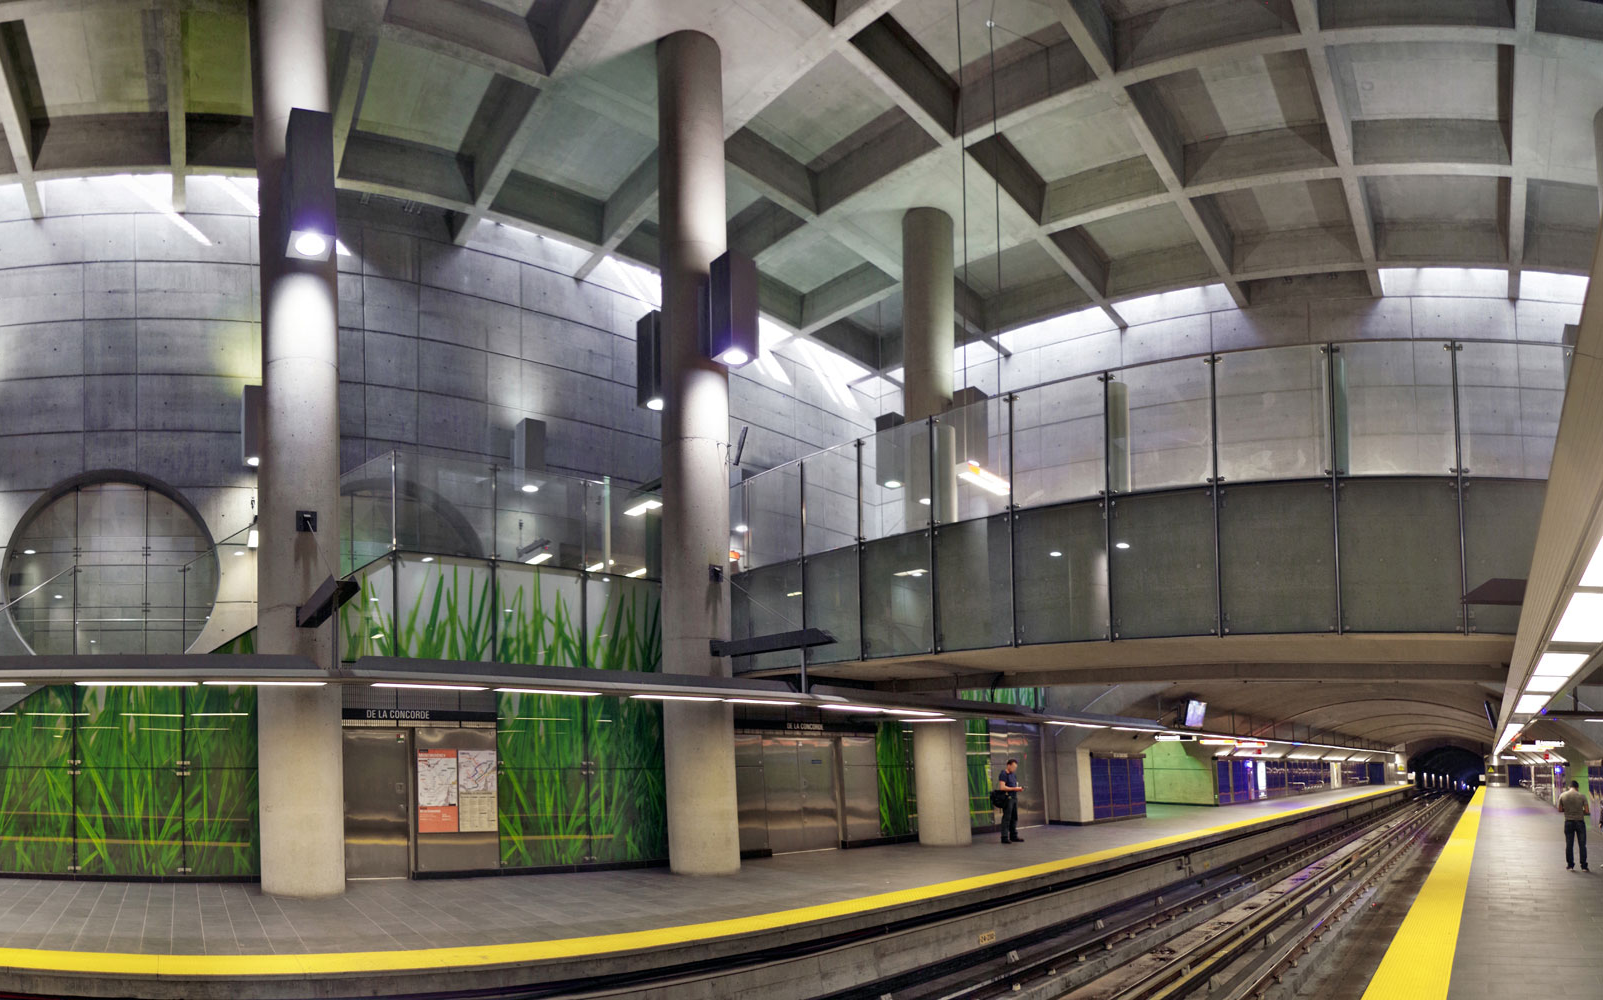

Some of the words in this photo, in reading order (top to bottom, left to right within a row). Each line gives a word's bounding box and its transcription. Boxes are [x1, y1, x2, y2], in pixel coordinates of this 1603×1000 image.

[366, 710, 376, 718] DE
[378, 710, 387, 719] LA
[389, 710, 430, 720] CONCORDE
